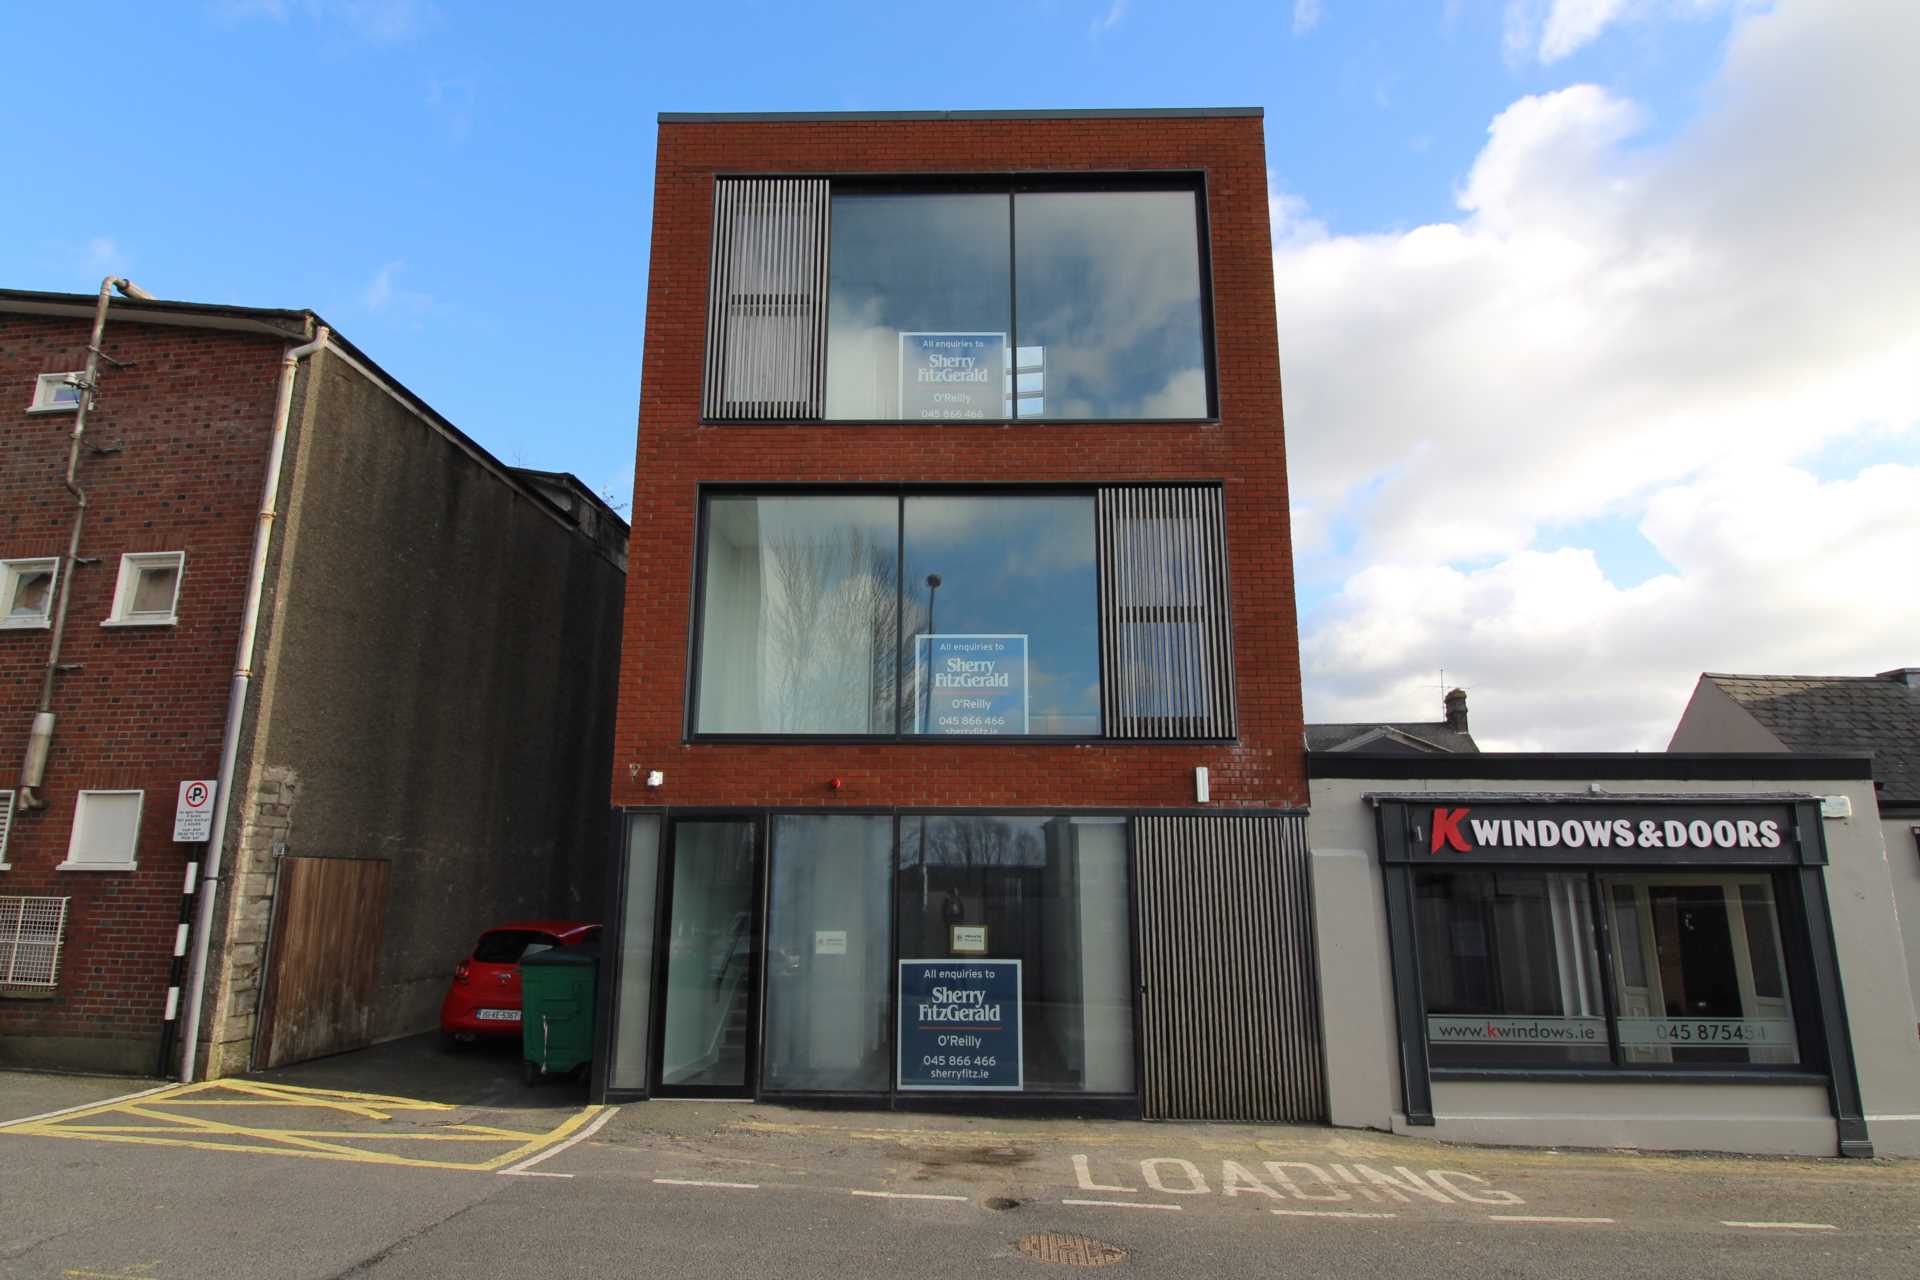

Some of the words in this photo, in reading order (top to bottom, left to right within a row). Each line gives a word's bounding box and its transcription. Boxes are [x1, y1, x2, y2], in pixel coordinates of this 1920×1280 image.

[923, 340, 933, 348] All
[935, 340, 973, 349] enquiries
[975, 340, 984, 348] to
[929, 354, 975, 371] Sherry
[918, 368, 988, 383] FitzGerald
[934, 393, 971, 405] O'Reilly
[921, 409, 941, 419] 045
[940, 643, 951, 651] All
[953, 643, 993, 653] enquiries
[995, 643, 1005, 651] to
[947, 658, 996, 675] Sherry
[935, 672, 1009, 688] FitzGerald
[952, 699, 992, 711] O'Reilly
[938, 716, 960, 726] 045
[961, 716, 983, 726] 866
[984, 716, 1006, 726] 466
[193, 787, 202, 801] P
[1431, 807, 1474, 855] K
[923, 969, 937, 979] All
[939, 969, 983, 980] enquiries
[985, 969, 996, 979] to
[931, 986, 986, 1008] Sherry
[918, 1004, 1001, 1022] FitzGerald
[1439, 1022, 1596, 1040] www.kwindows.ie
[1657, 1024, 1691, 1041] 045
[937, 1035, 982, 1049] O'Reilly
[923, 1055, 946, 1066] 045
[948, 1055, 971, 1066] 866
[973, 1055, 996, 1066] 466
[930, 1068, 989, 1081] sherryfitz.ie
[1071, 1154, 1526, 1205] LOADING
